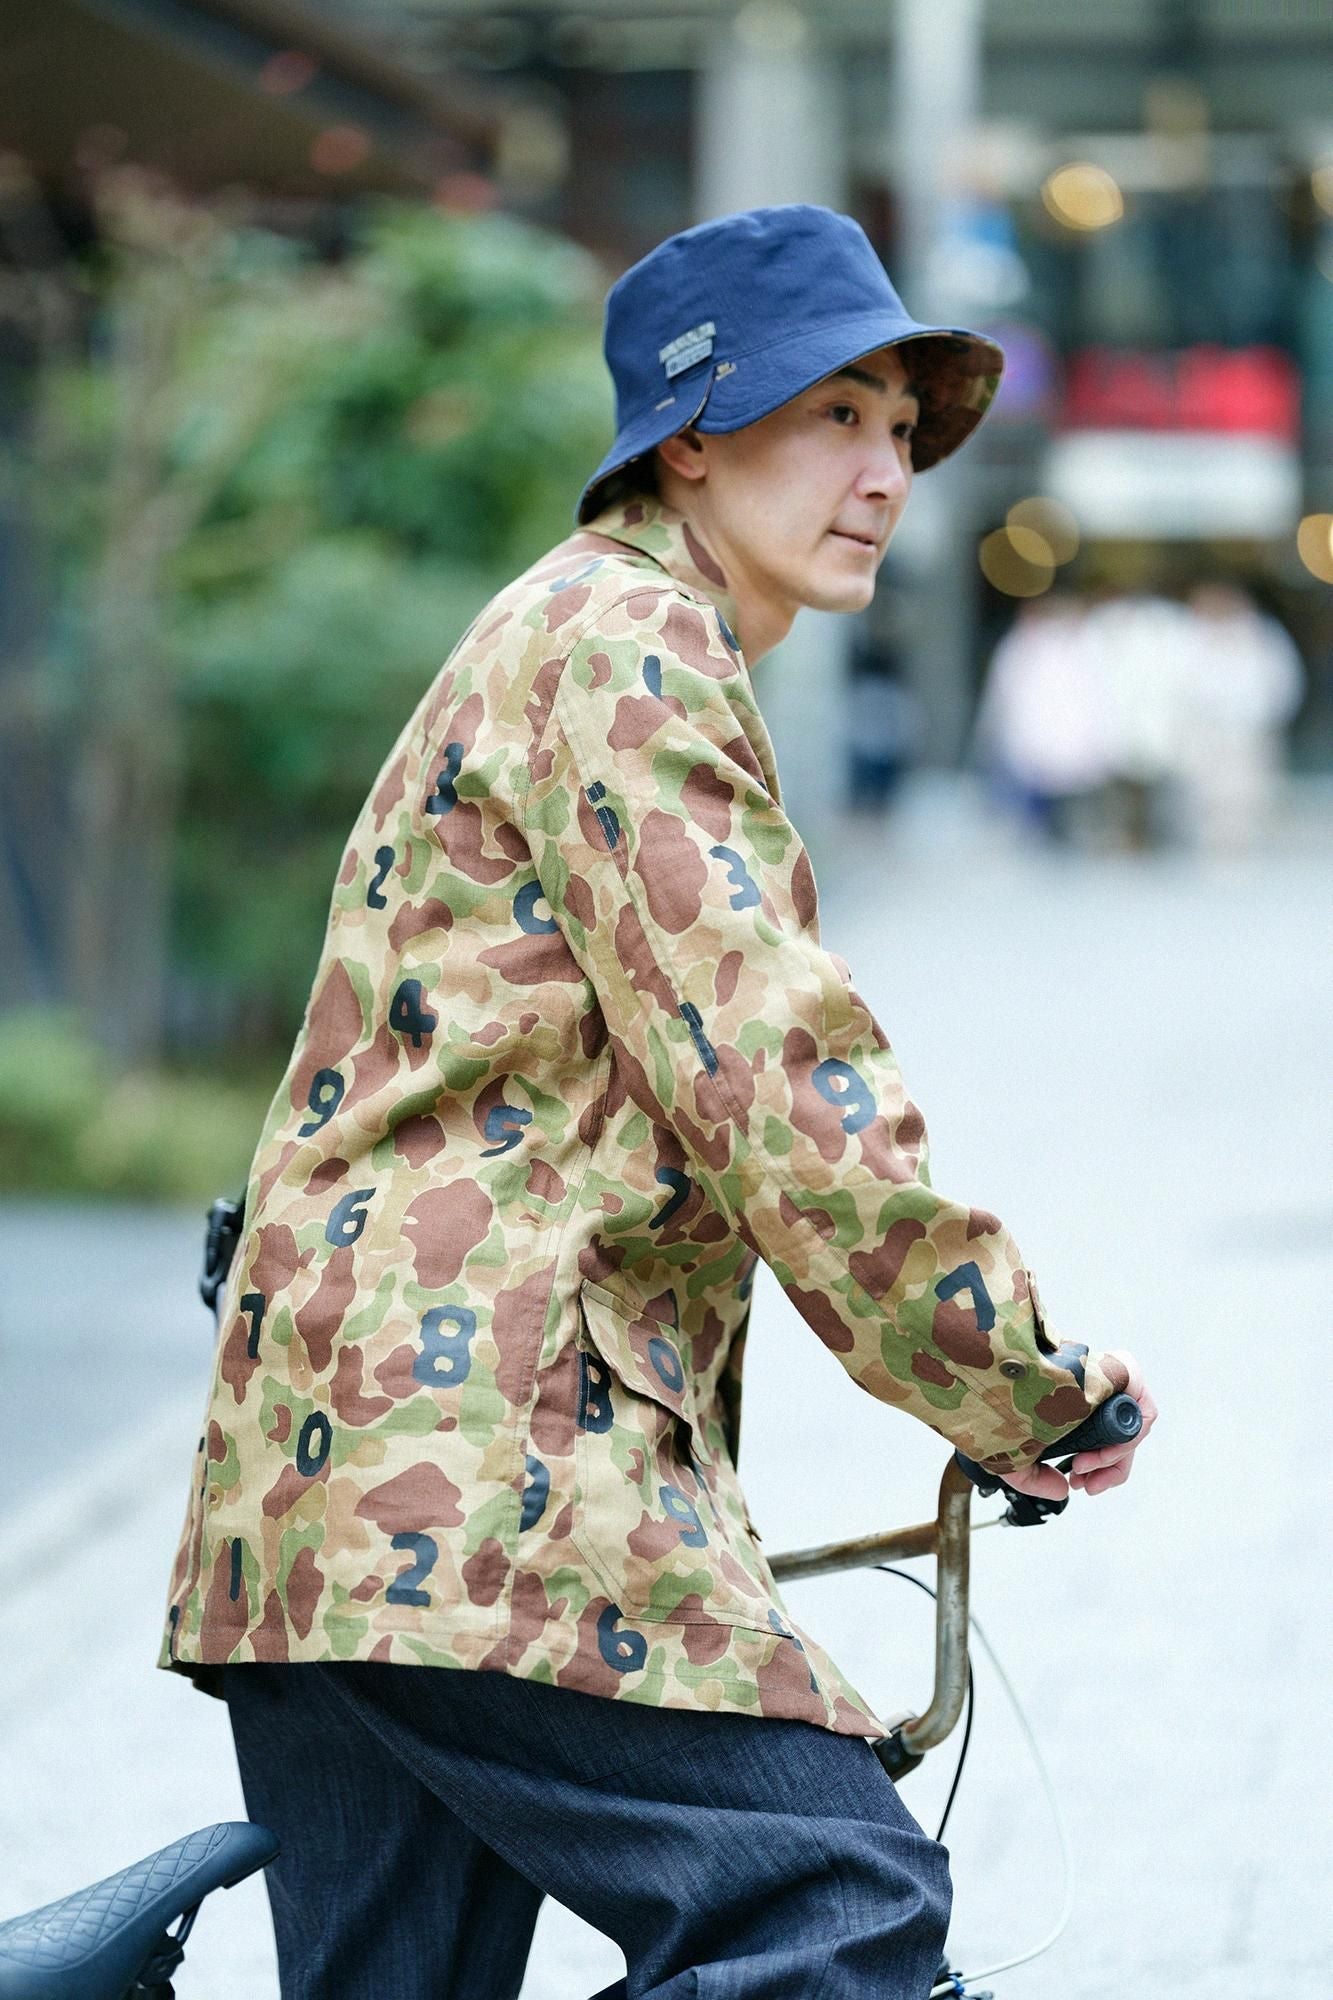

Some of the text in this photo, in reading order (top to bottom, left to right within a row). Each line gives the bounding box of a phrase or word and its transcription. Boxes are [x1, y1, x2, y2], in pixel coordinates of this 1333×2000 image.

[708, 844, 761, 911] 3
[389, 979, 437, 1048] 4
[297, 1068, 344, 1137] 9
[812, 1057, 878, 1135] 9
[325, 1187, 376, 1248] 6
[649, 1167, 691, 1230] 7
[935, 1261, 995, 1332] 7
[413, 1304, 477, 1389] 8
[648, 1338, 684, 1393] 0
[296, 1411, 333, 1477] 0
[659, 1485, 708, 1548] 9
[386, 1532, 438, 1607] 2
[597, 1603, 648, 1673] 6
